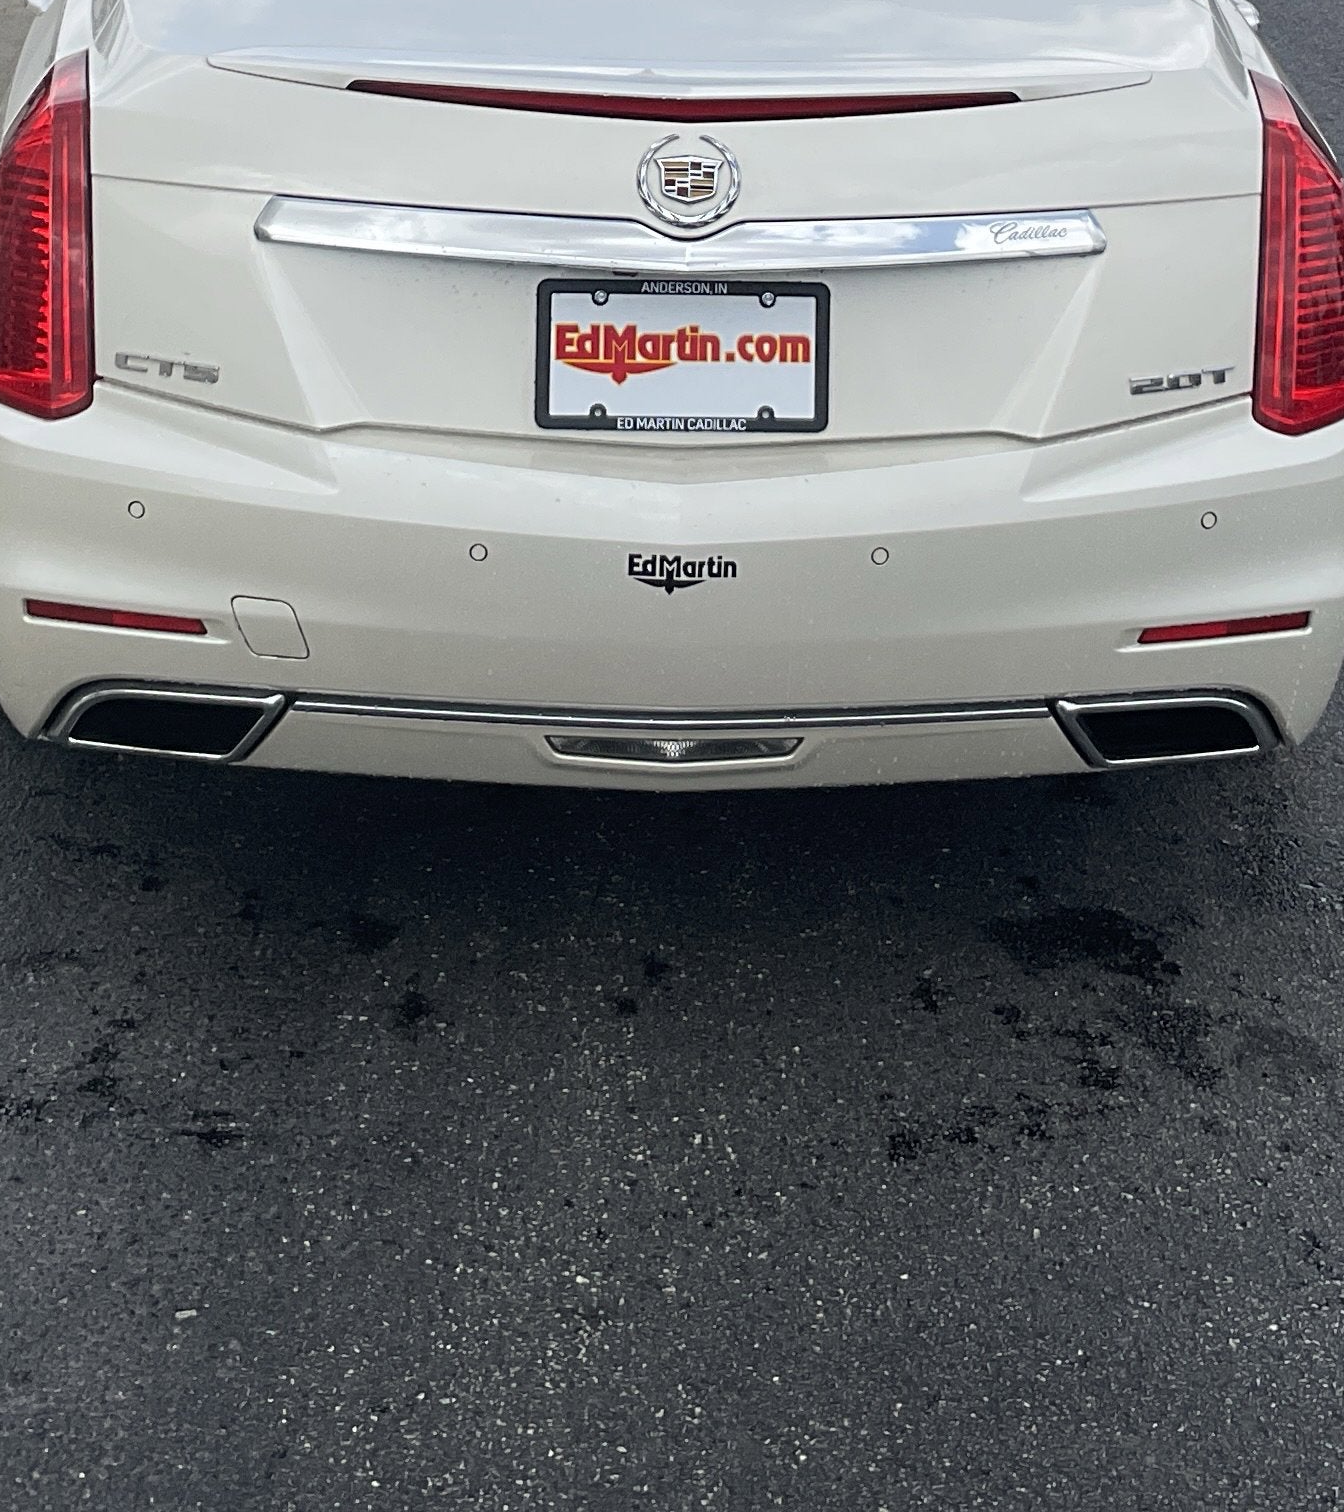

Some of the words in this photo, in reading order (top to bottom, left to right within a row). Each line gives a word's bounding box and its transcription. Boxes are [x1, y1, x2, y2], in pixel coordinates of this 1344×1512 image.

[989, 221, 1068, 245] Cadillac
[641, 281, 713, 295] ANDERSON,
[715, 282, 728, 295] IN
[115, 352, 220, 384] CTS
[617, 417, 633, 430] ED
[636, 417, 686, 431] MARTIN
[687, 418, 747, 431] CADILLAC
